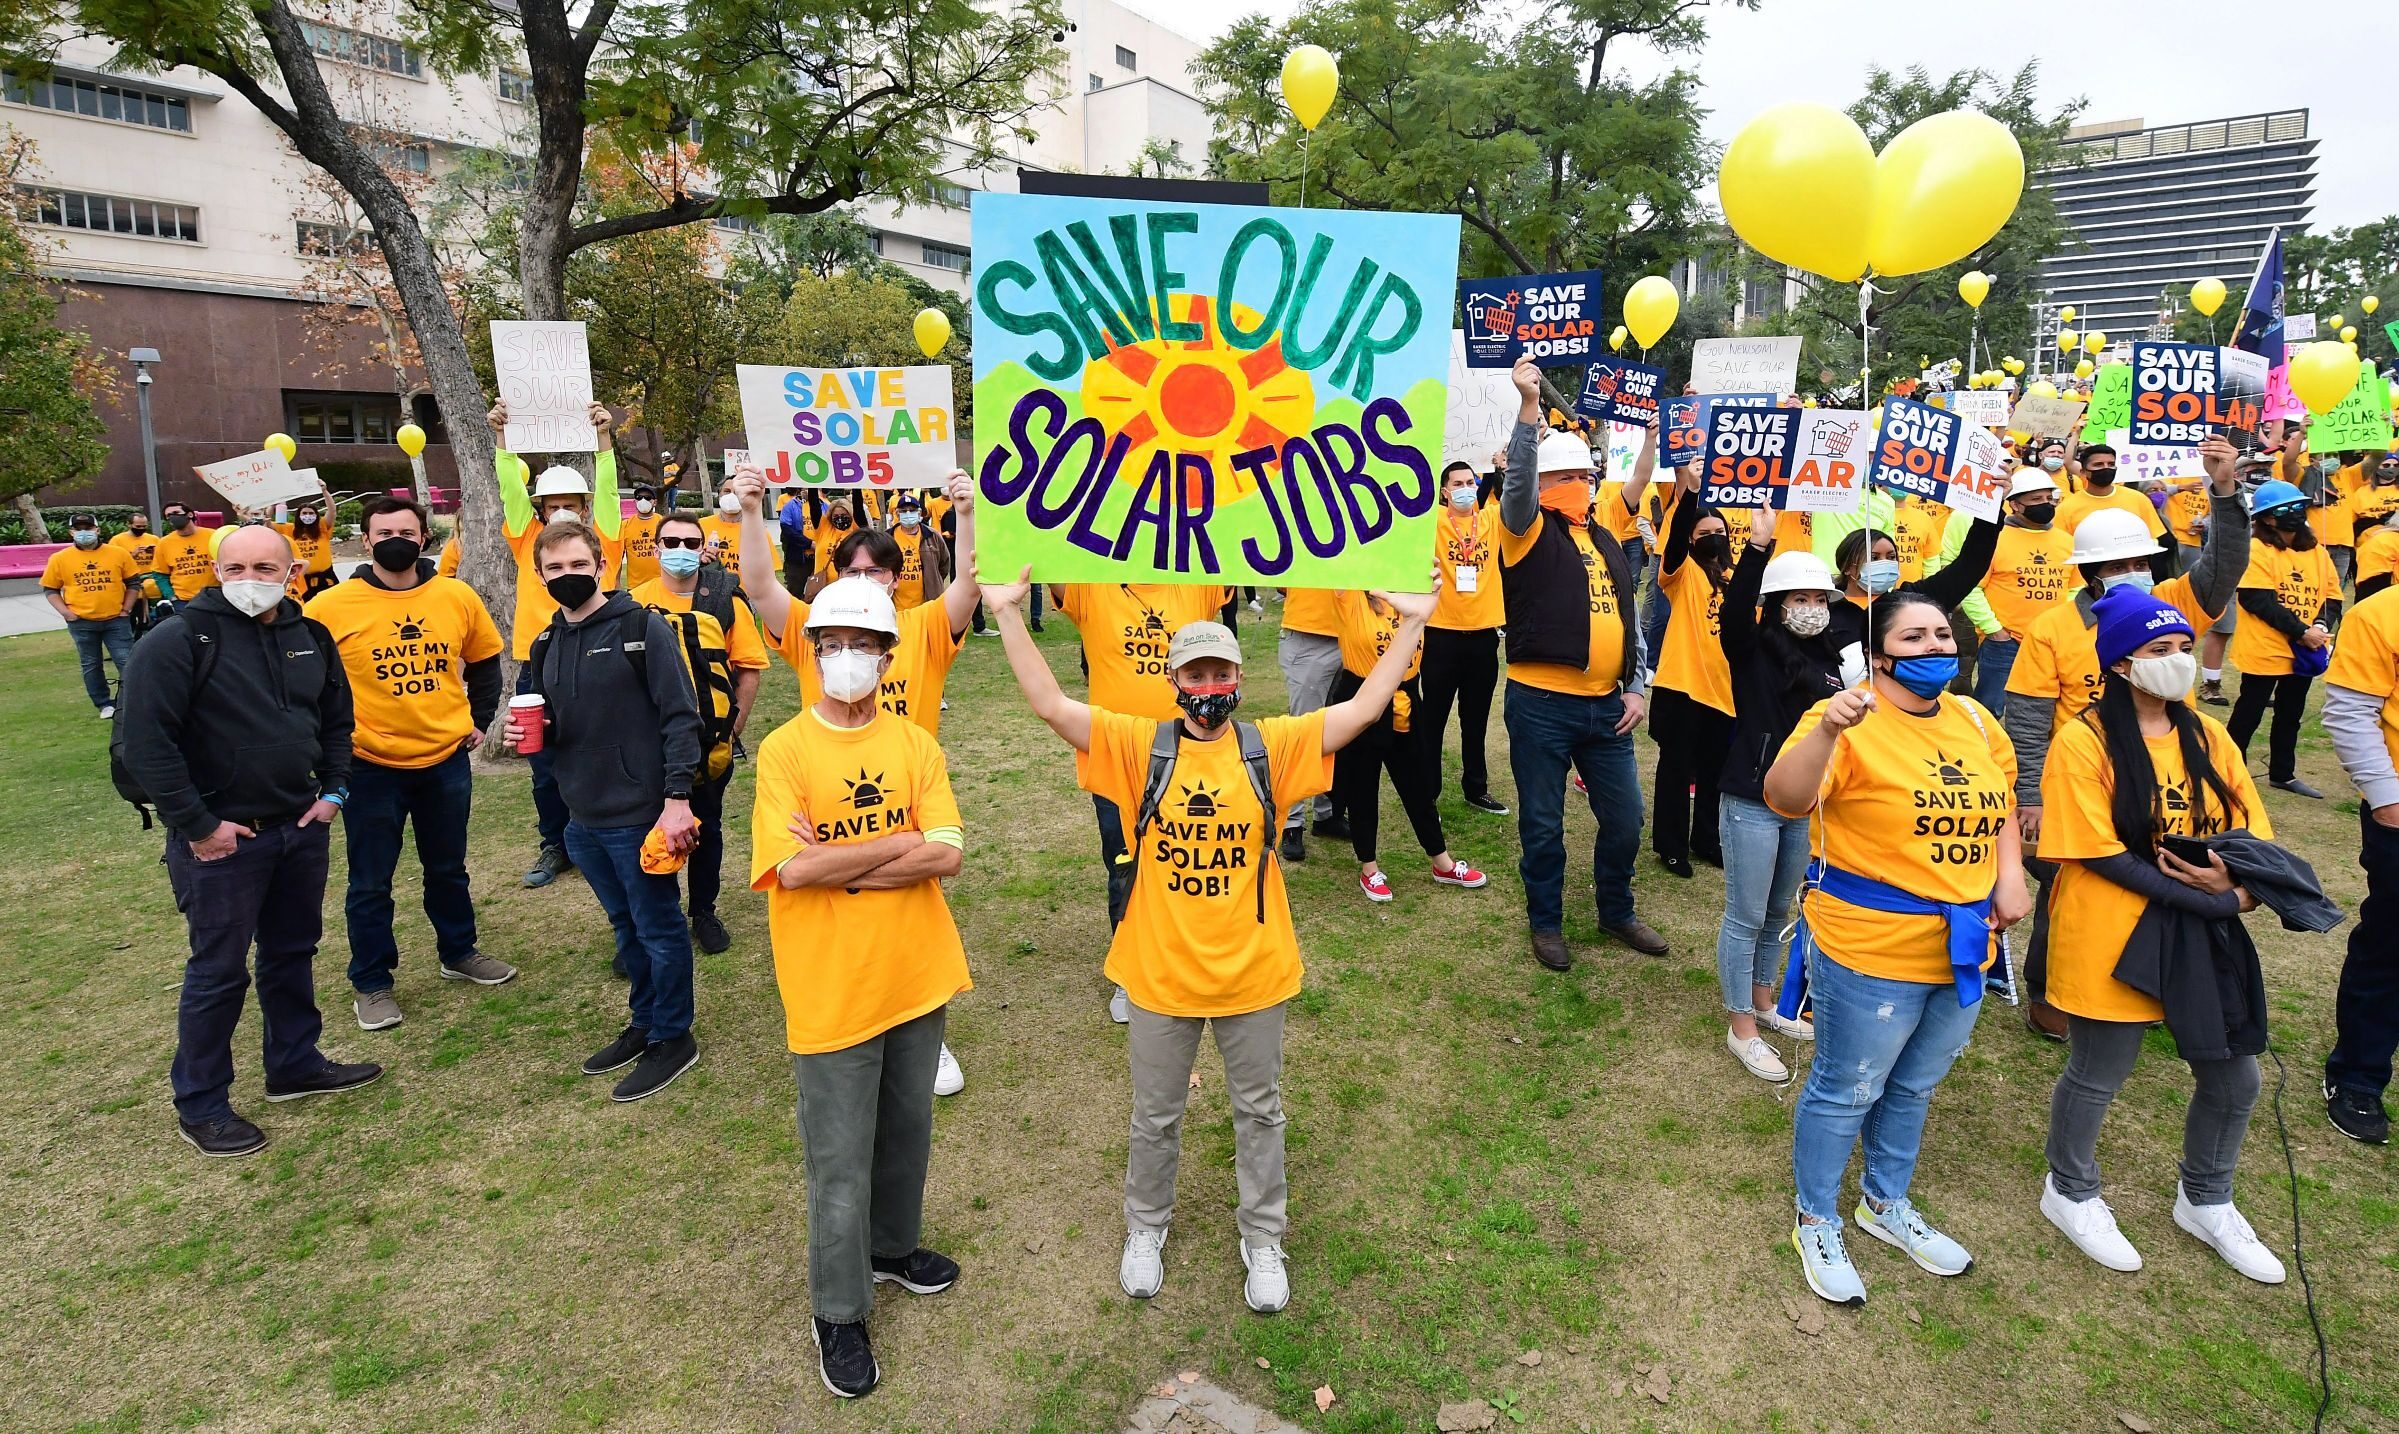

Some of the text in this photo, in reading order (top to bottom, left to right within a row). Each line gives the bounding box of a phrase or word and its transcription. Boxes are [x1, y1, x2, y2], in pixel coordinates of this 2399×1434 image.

[1524, 283, 1586, 305] SAVE
[976, 212, 1423, 404] SAVE OUR
[1529, 303, 1581, 322] OUR
[1516, 320, 1595, 341] SOLAR
[501, 329, 588, 372] SAVE
[1522, 338, 1589, 358] JOBS!
[1707, 360, 1786, 374] SAVE OUR
[2139, 347, 2215, 371] SAVE
[1625, 369, 1658, 387] SAVE
[2138, 368, 2215, 394] OUR
[503, 374, 589, 412] OUR
[783, 370, 906, 409] SAVE
[1625, 382, 1653, 398] OUR
[1615, 392, 1657, 410] SOLAR
[1982, 400, 2002, 409] GREEN
[1889, 402, 1953, 435] SAVE
[2137, 392, 2258, 433] SOLAR
[2325, 409, 2379, 428] SOLAR
[509, 413, 598, 451] JOBS
[792, 407, 948, 446] SOLAR
[1716, 412, 1790, 434] SAVE
[2135, 423, 2215, 442] JOBS!
[1714, 431, 1786, 457] OUR
[1886, 420, 1949, 456] OUR
[2334, 428, 2380, 445] JOBS
[1708, 456, 1856, 489] SOLAR
[1880, 440, 1998, 500] SOLAR
[2138, 465, 2179, 479] TAX
[979, 389, 1435, 576] SOLAR JOBS
[1875, 465, 1938, 496] JOBS!
[1704, 486, 1774, 504] JOBS!
[1474, 540, 1488, 550] MY
[1908, 535, 1921, 543] MY
[73, 569, 112, 579] SAVE MY
[176, 560, 210, 570] SOLAR
[2016, 567, 2064, 576] SAVE MY
[76, 577, 112, 585] SOLAR
[83, 585, 107, 593] JOB!
[2017, 577, 2063, 589] SOLAR
[2025, 590, 2058, 600] JOB!
[2305, 587, 2319, 595] MY
[1590, 600, 1616, 614] OB!
[2278, 594, 2318, 608] SOLAR
[371, 642, 449, 661] SAVE MY
[375, 659, 449, 680] SOLAR
[392, 678, 441, 697] JOB!
[881, 680, 907, 696] MY
[1914, 790, 2006, 810] SAVE MY
[816, 813, 880, 843] SAVE
[1216, 822, 1251, 841] MY
[1913, 815, 2006, 838] SOLAR
[1156, 840, 1247, 869] SOLAR
[1931, 843, 1989, 864] JOB!
[1168, 872, 1230, 897] JOB!
